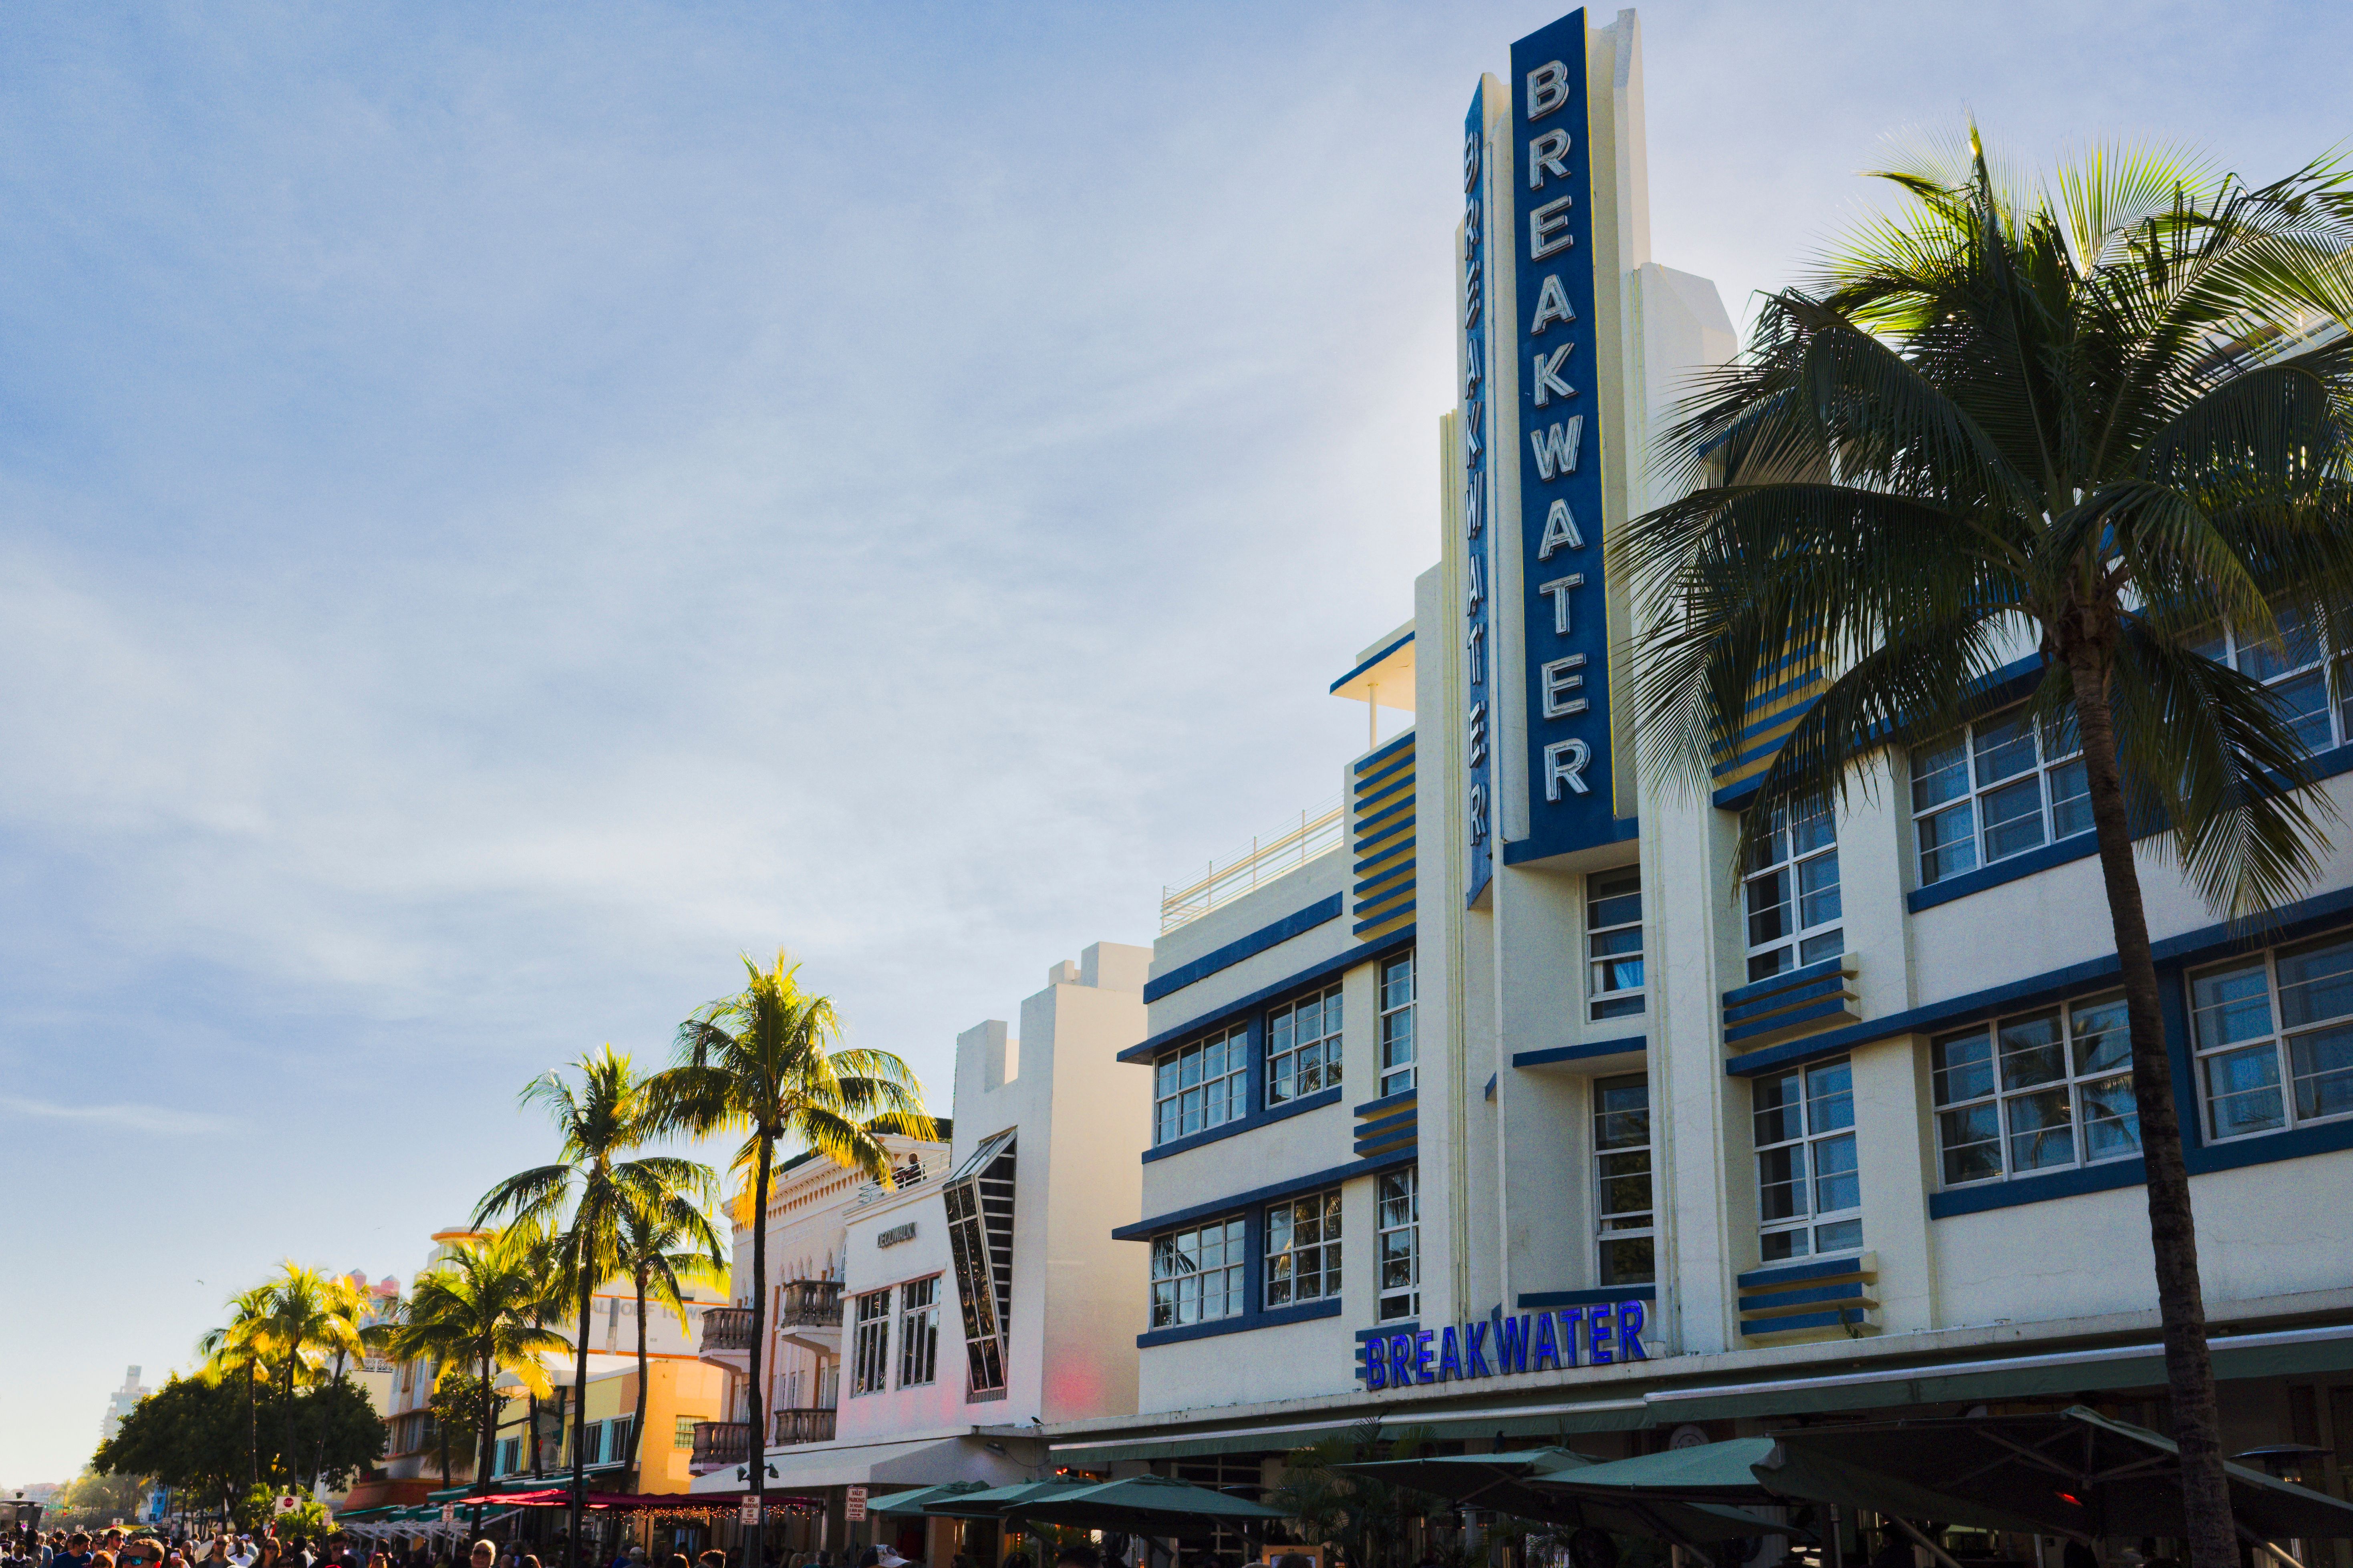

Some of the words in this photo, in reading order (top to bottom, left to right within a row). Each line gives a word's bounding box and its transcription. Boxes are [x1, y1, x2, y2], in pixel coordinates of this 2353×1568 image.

[1464, 131, 1486, 846] BREAKWATER
[1527, 59, 1592, 802] BREAKWATER
[1365, 1300, 1649, 1391] BREAKWATER
